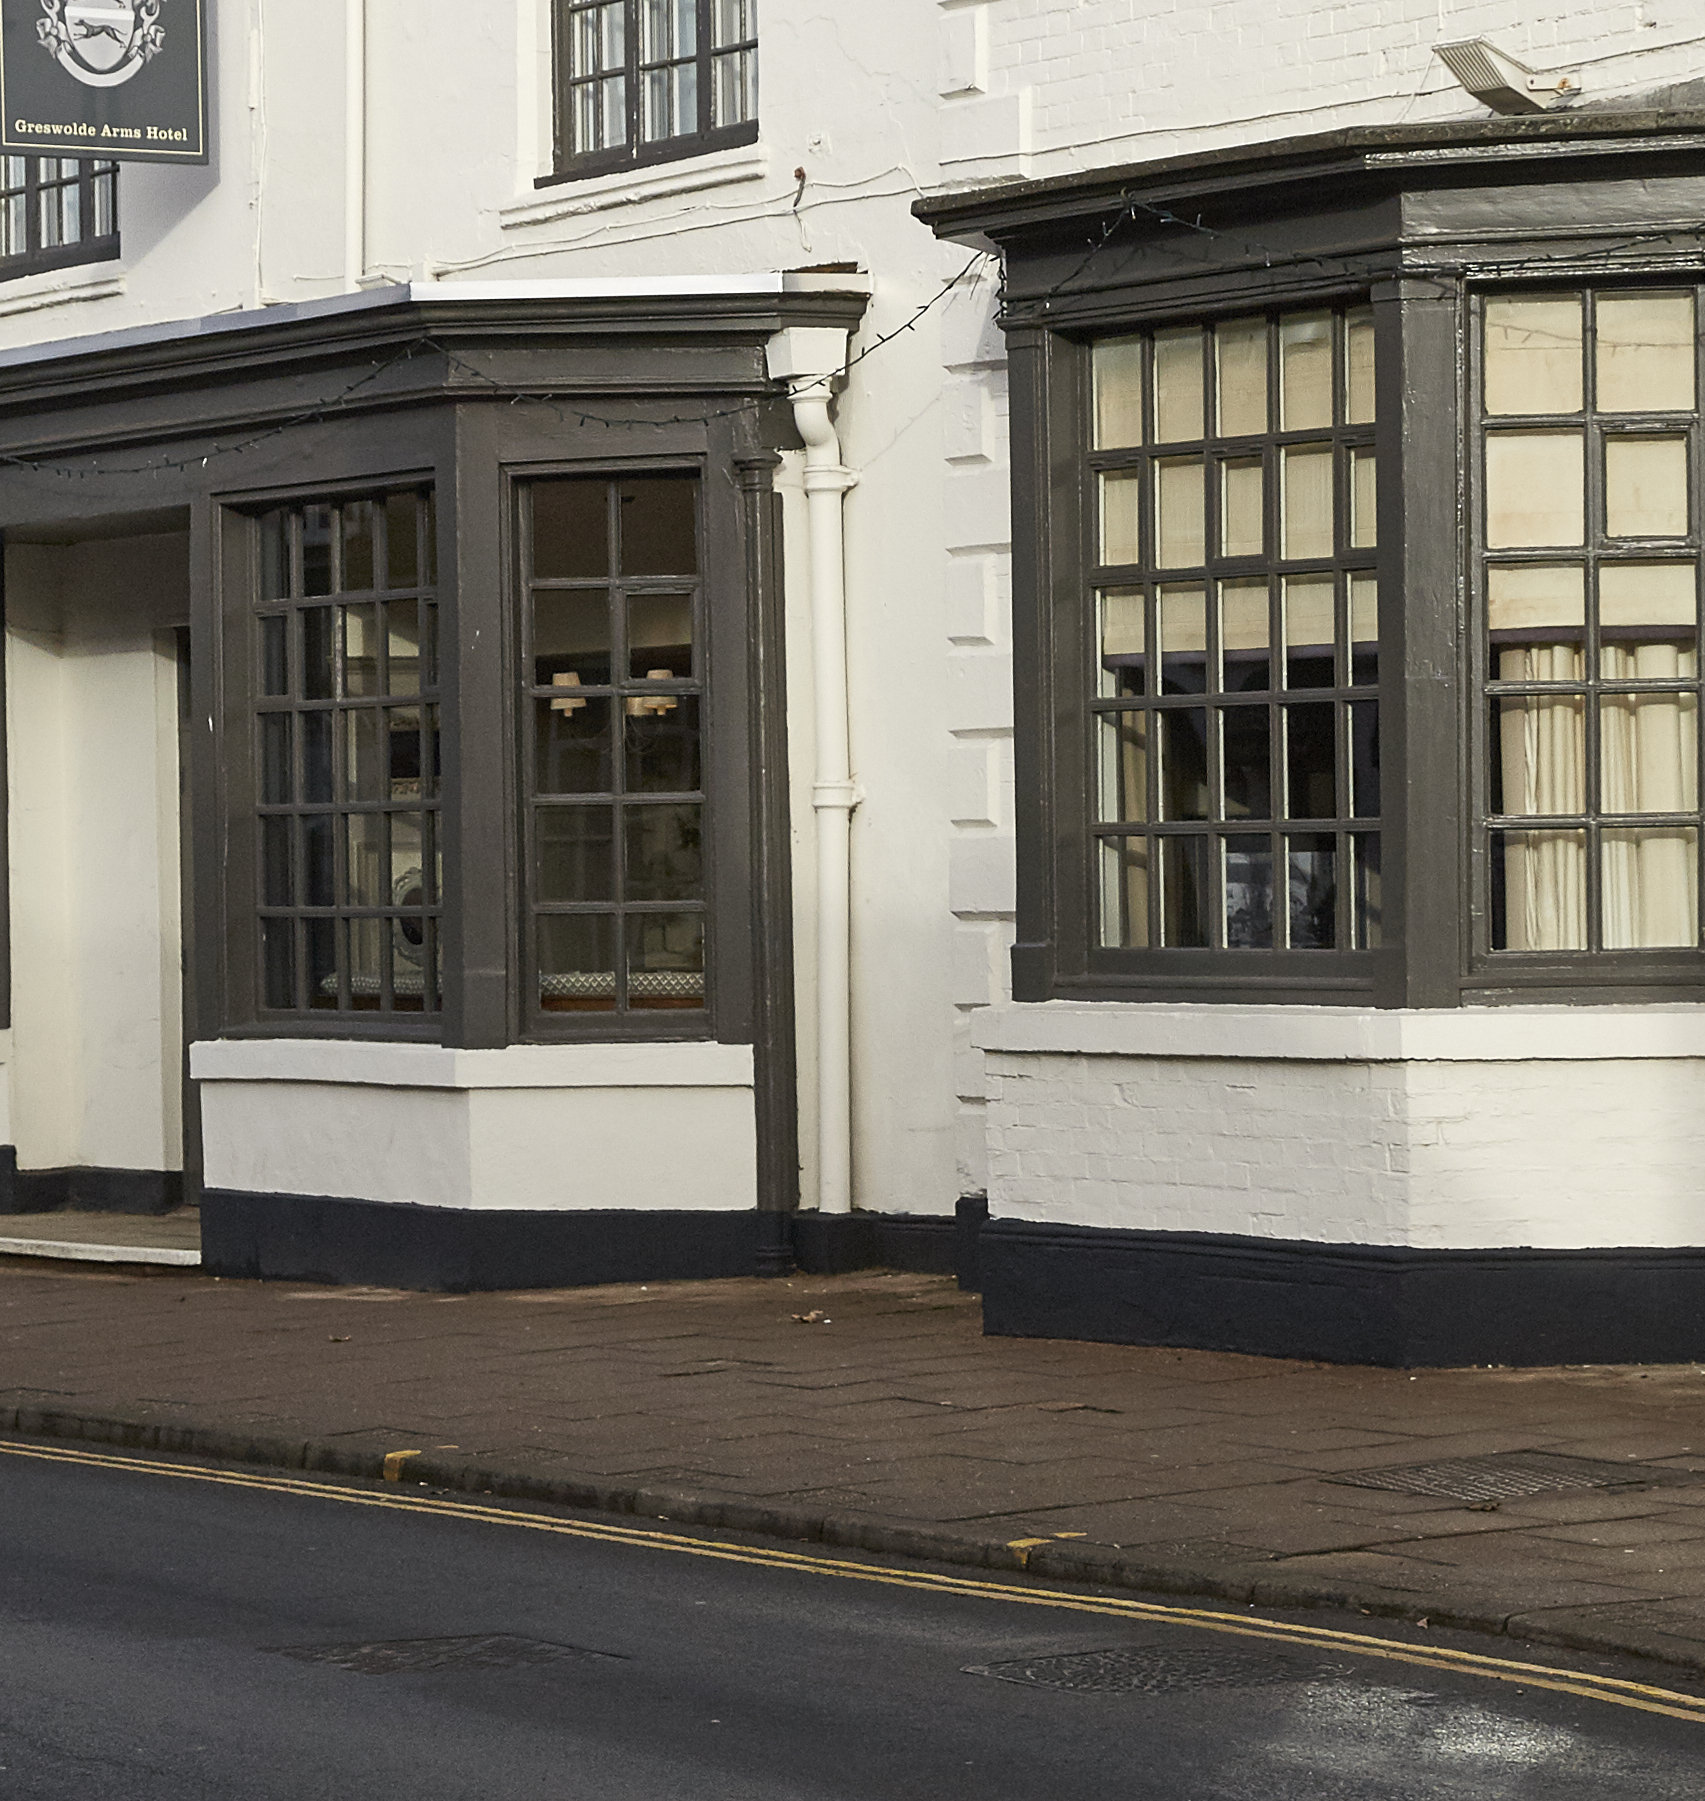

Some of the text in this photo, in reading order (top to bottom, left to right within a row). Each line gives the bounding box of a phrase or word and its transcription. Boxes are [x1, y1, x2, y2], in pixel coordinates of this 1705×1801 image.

[14, 119, 188, 141] Greswolde Arms Hotel
